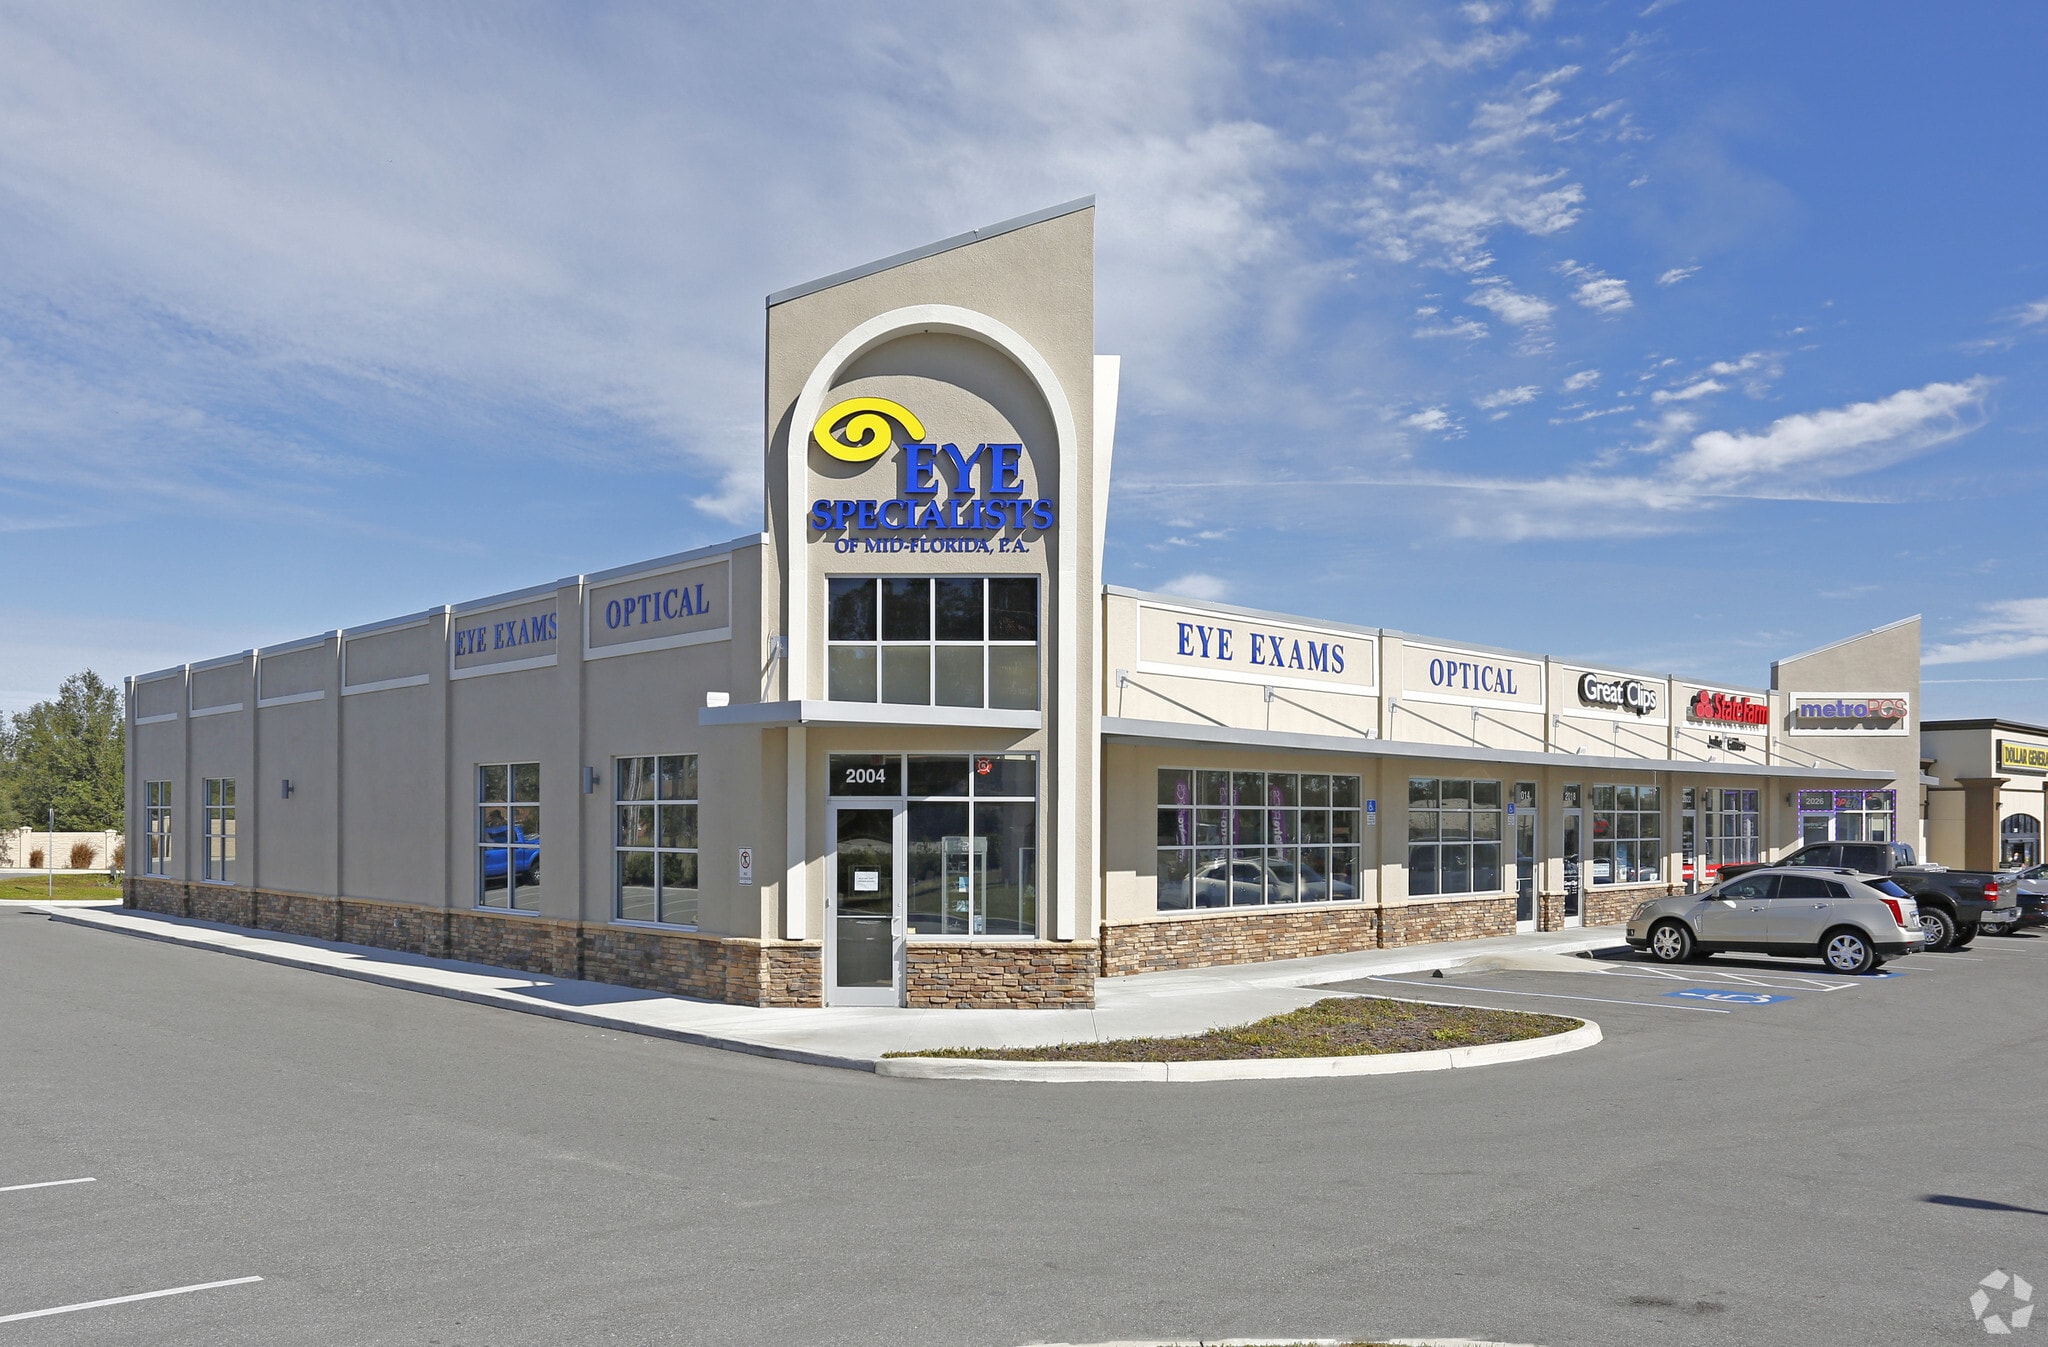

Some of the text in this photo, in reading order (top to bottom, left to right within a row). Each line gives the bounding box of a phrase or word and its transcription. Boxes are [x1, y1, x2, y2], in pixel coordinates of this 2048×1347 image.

[902, 443, 1024, 495] EYE
[811, 498, 1054, 531] SPECIALISTS
[835, 538, 858, 554] OF
[864, 538, 995, 556] MID-FLORIDA,
[606, 583, 710, 629] OPTICAL
[455, 612, 557, 656] EYE EXAMS
[1176, 621, 1345, 674] EYE EXAMS
[1429, 658, 1518, 695] OPTICAL
[1584, 673, 1657, 714] Great Clips
[1800, 699, 1908, 718] metroPCS
[2005, 746, 2028, 765] DOLLAR
[845, 768, 886, 783] 2004
[1520, 791, 1531, 800] 014
[1564, 792, 1577, 801] 2018
[1805, 797, 1825, 805] 2026
